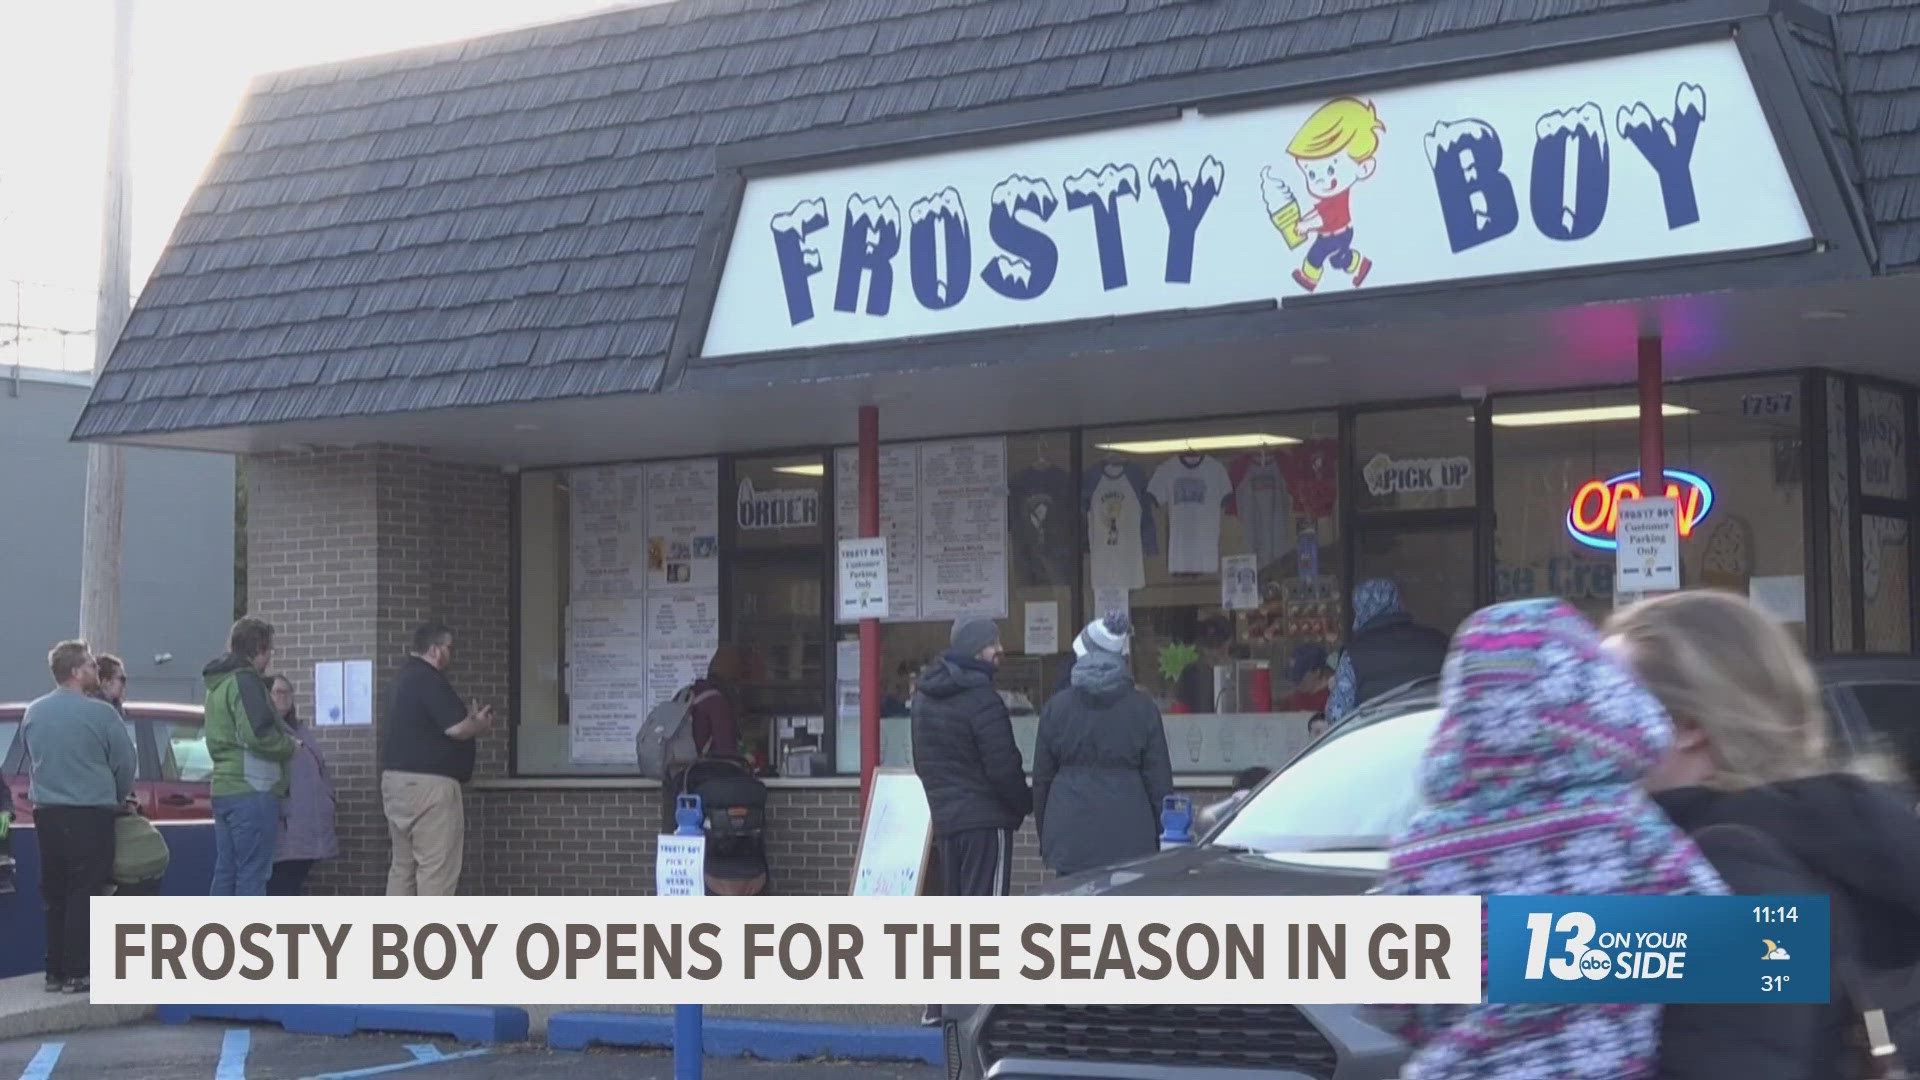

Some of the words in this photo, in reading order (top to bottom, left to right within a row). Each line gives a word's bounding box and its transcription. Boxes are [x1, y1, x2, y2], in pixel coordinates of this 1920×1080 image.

[770, 155, 1225, 327] FROSTY
[1423, 81, 1706, 254] BOY
[1741, 394, 1793, 416] 1757
[1383, 464, 1434, 491] PICK
[1441, 459, 1473, 487] UP
[738, 493, 818, 527] ORDER
[1572, 479, 1701, 540] OPN
[1624, 521, 1670, 532] Customer
[1629, 534, 1667, 545] Parking
[1636, 546, 1659, 557] Only
[846, 560, 880, 569] Customer
[850, 570, 878, 579] Parking
[855, 581, 871, 589] Only
